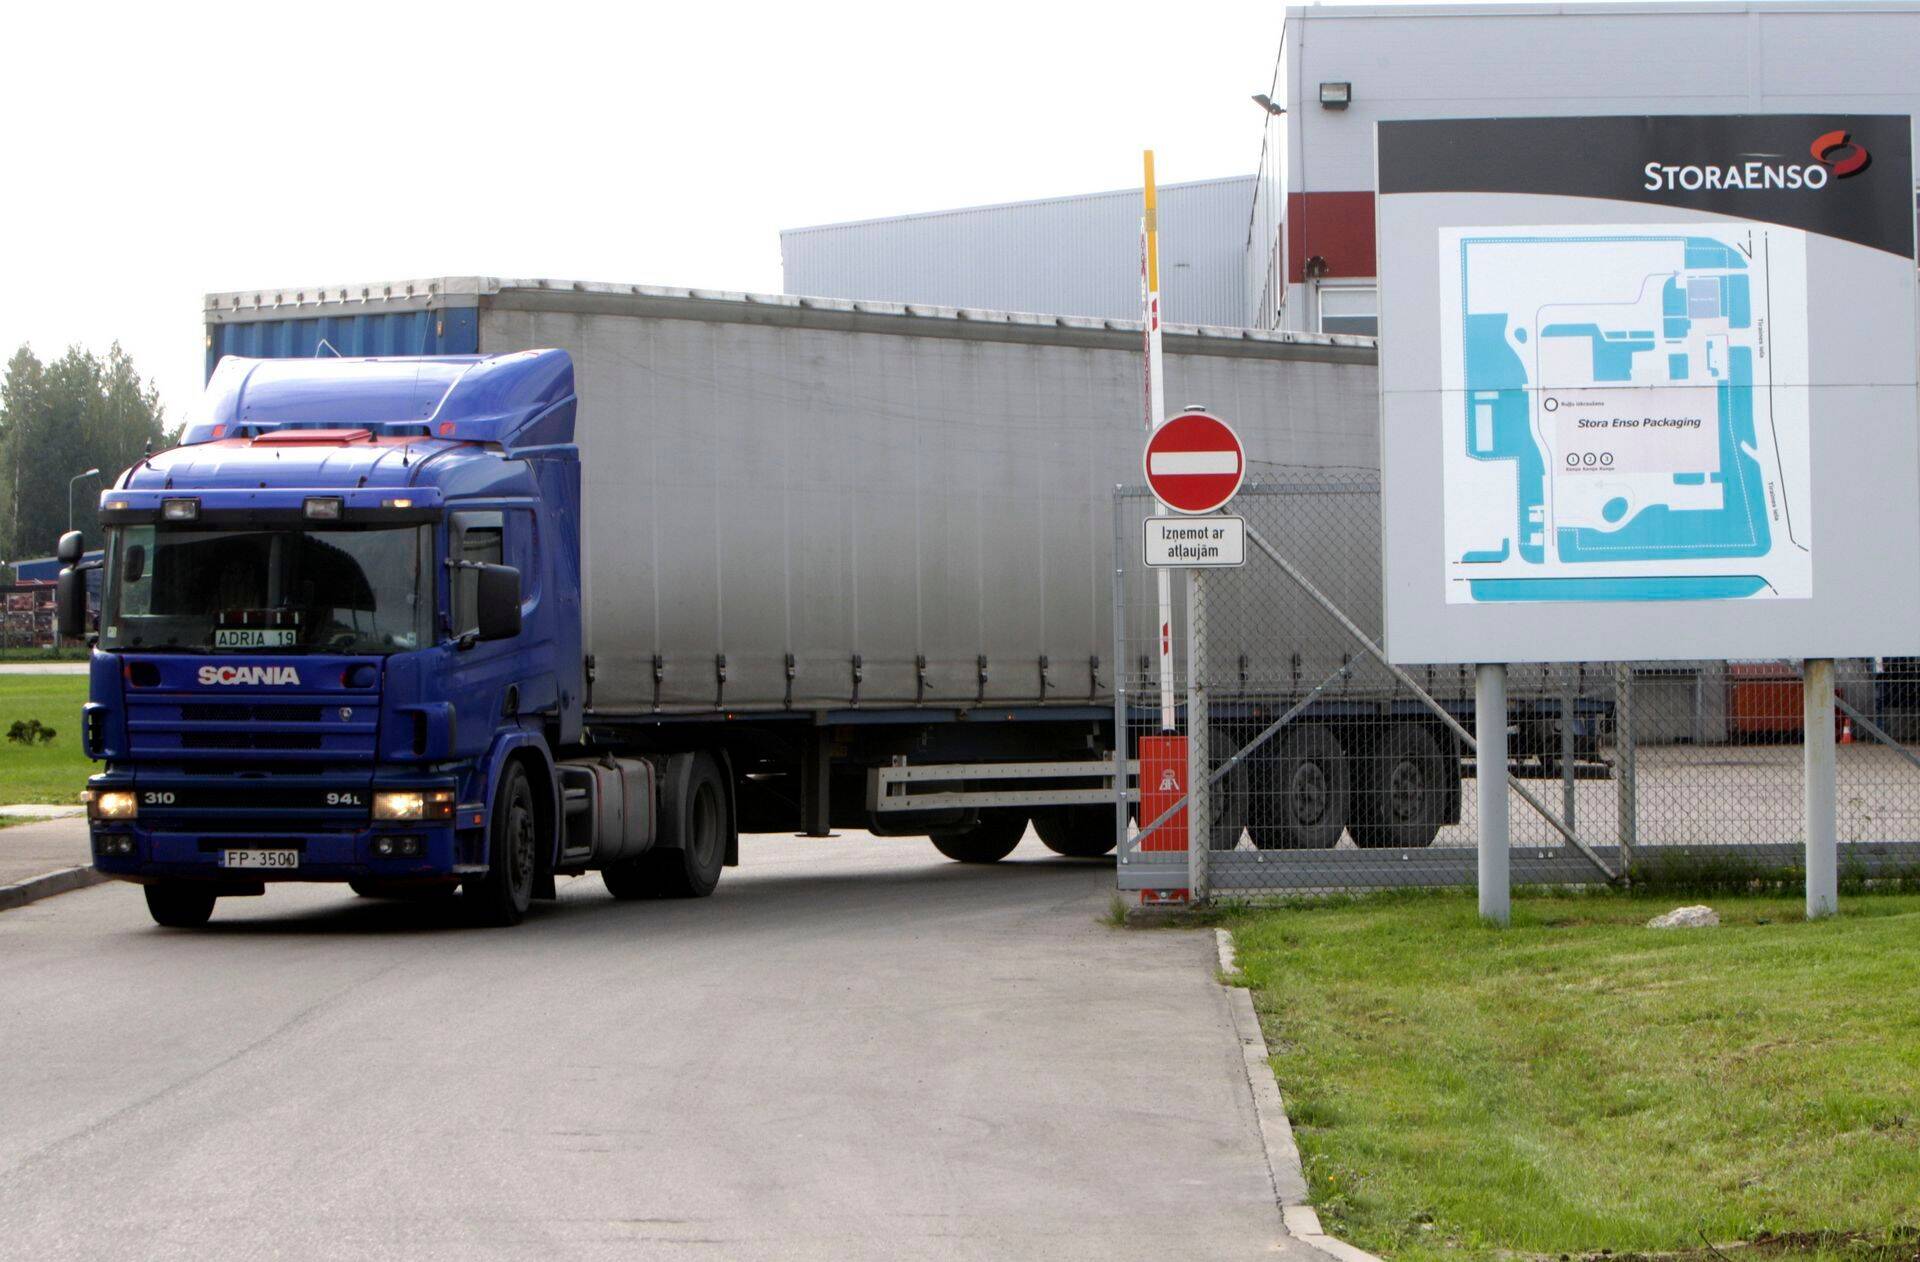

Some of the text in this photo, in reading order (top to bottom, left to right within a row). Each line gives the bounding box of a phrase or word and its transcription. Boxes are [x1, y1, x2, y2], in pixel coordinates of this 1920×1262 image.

[1577, 417, 1702, 429] Stora Enso Packaging
[1162, 525, 1225, 542] Izņemot ar
[1168, 543, 1219, 561] atļaujām
[218, 631, 295, 646] ADRIA 19
[198, 665, 301, 685] SCANIA
[144, 792, 176, 804] 310
[326, 792, 361, 805] 94L
